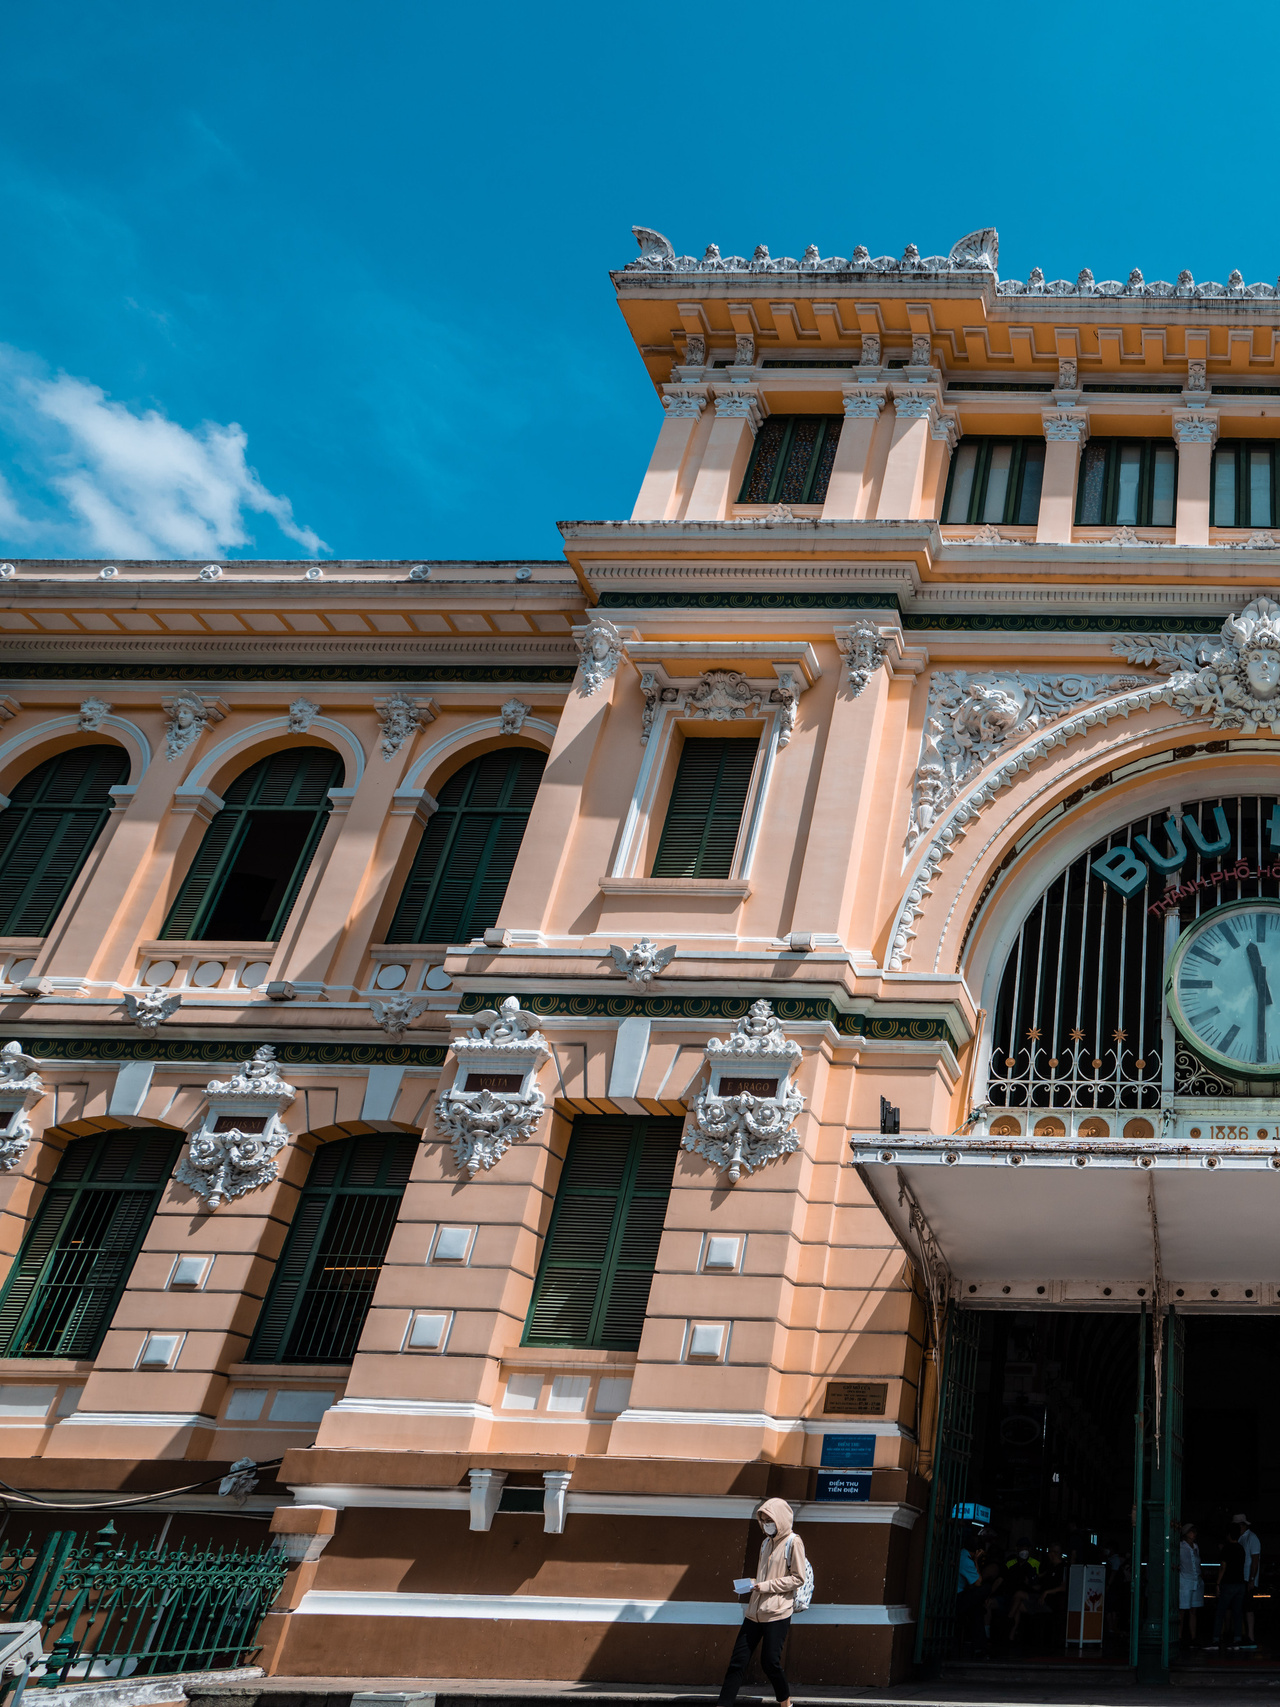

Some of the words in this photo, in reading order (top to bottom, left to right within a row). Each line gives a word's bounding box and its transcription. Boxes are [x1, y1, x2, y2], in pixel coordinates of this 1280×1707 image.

[1148, 875, 1208, 918] THÀNH
[1210, 857, 1251, 886] PHỐ
[479, 1077, 507, 1087] VOLTA
[737, 1082, 770, 1092] ARAGO
[1210, 1126, 1249, 1140] 1886
